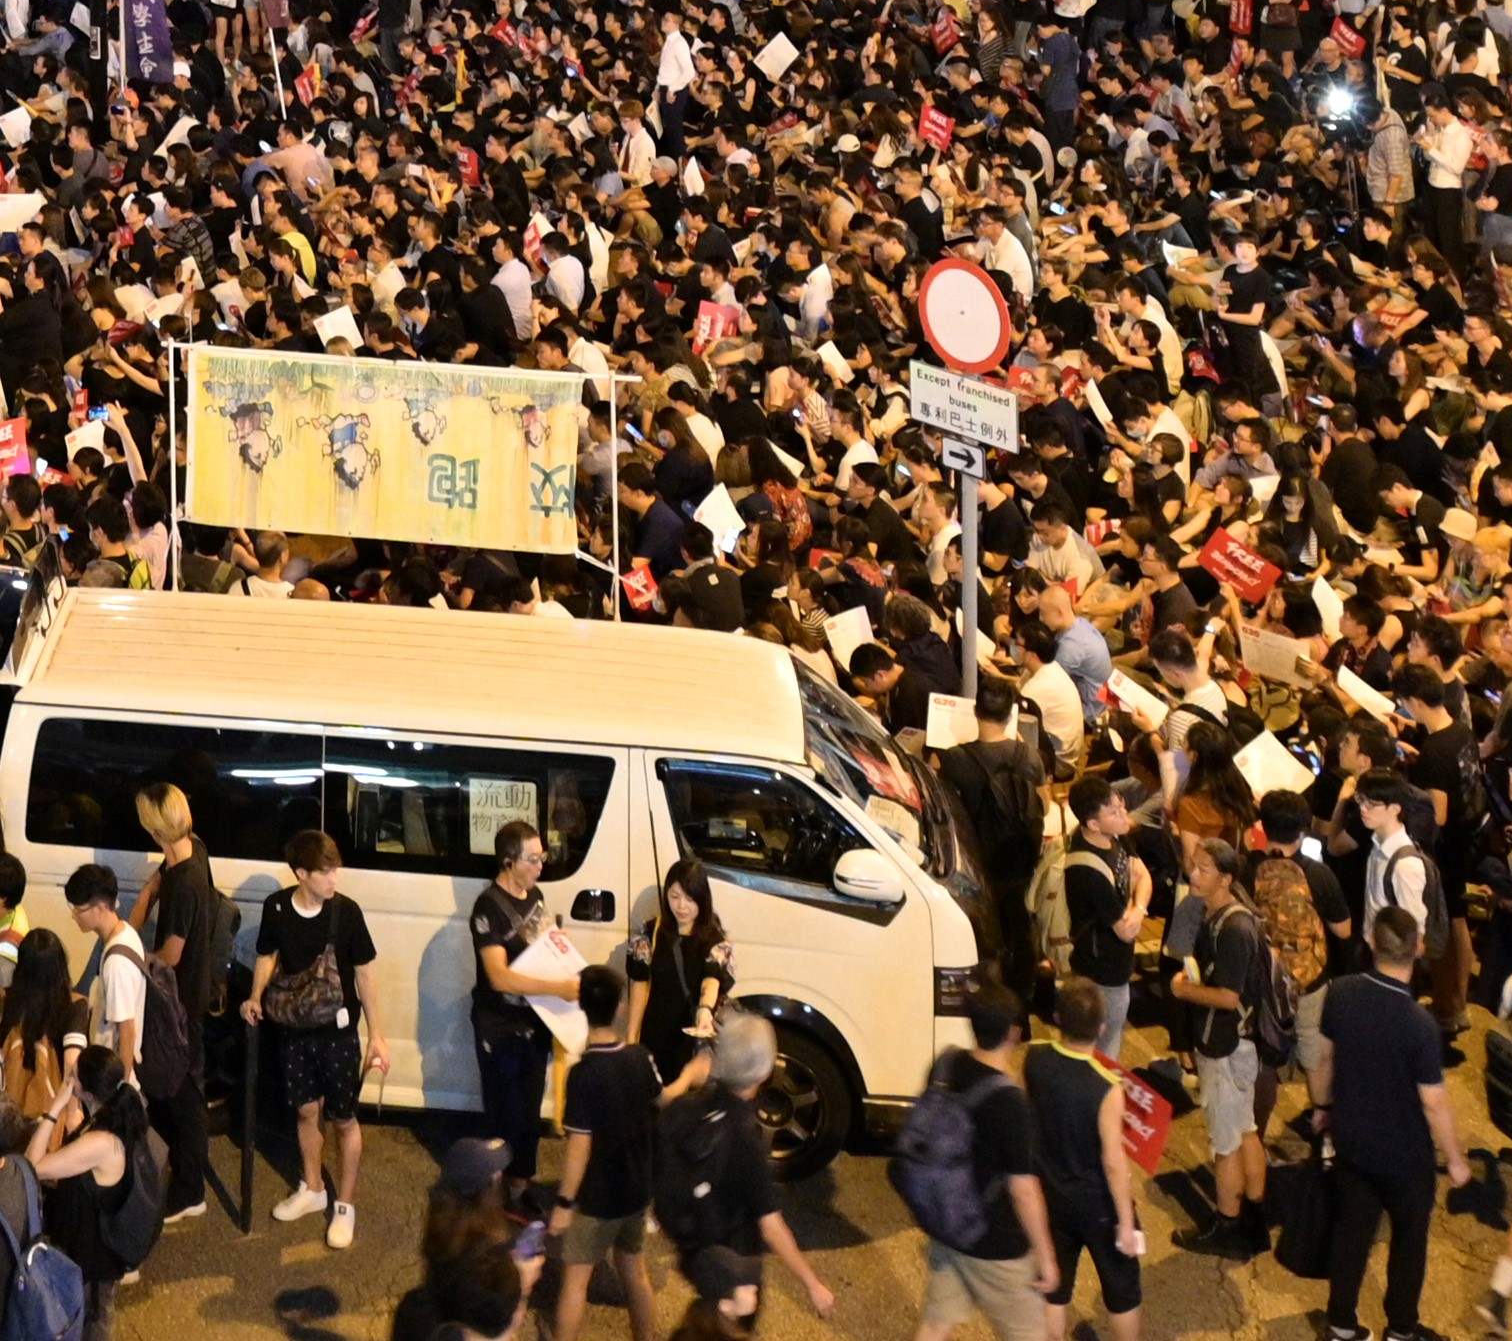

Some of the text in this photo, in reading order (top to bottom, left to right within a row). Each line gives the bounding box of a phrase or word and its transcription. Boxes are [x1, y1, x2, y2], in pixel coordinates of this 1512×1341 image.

[917, 368, 1010, 407] Except franchised
[949, 395, 978, 413] buses
[920, 402, 1008, 445] 專利巴士例外
[1226, 541, 1266, 574] FREE
[476, 781, 532, 811] 流動
